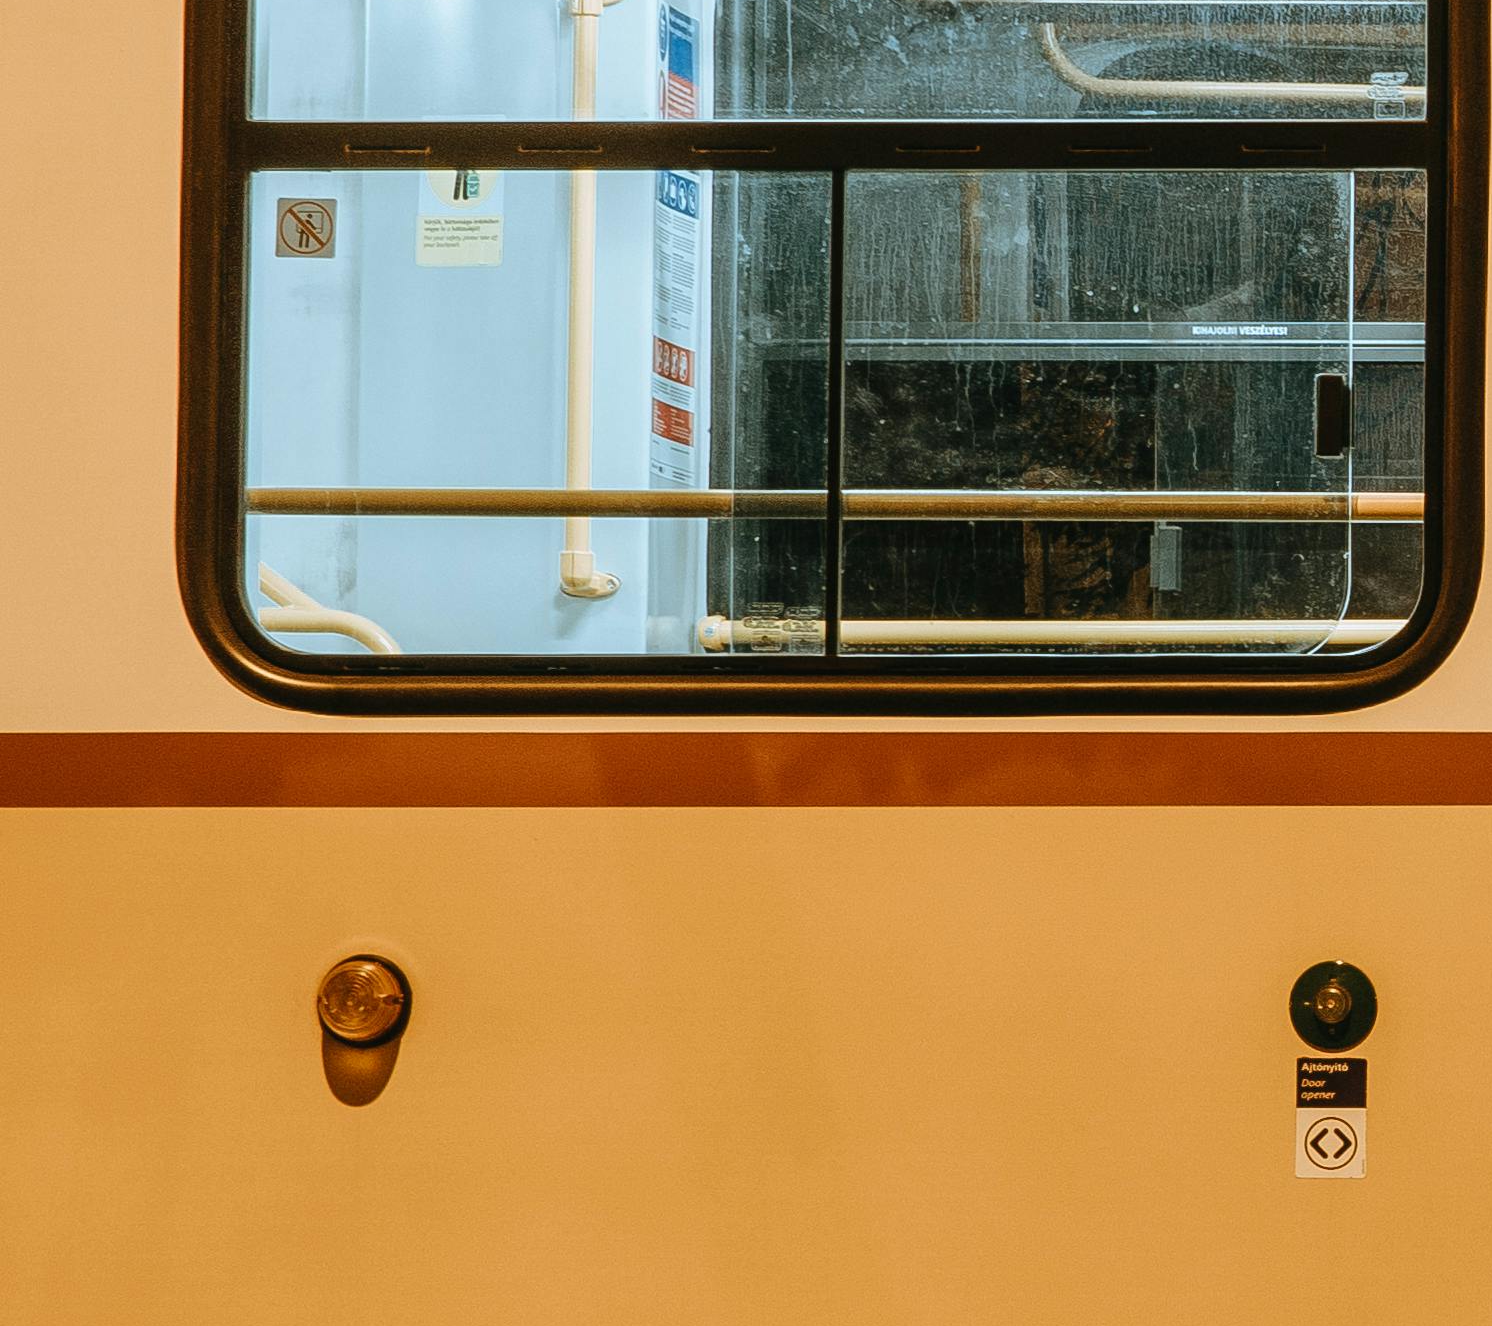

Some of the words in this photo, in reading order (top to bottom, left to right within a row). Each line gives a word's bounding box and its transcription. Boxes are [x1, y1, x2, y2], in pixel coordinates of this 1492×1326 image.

[1301, 1062, 1350, 1074] Ajtónyító
[1301, 1078, 1327, 1087] Door
[1300, 1091, 1337, 1102] opener
